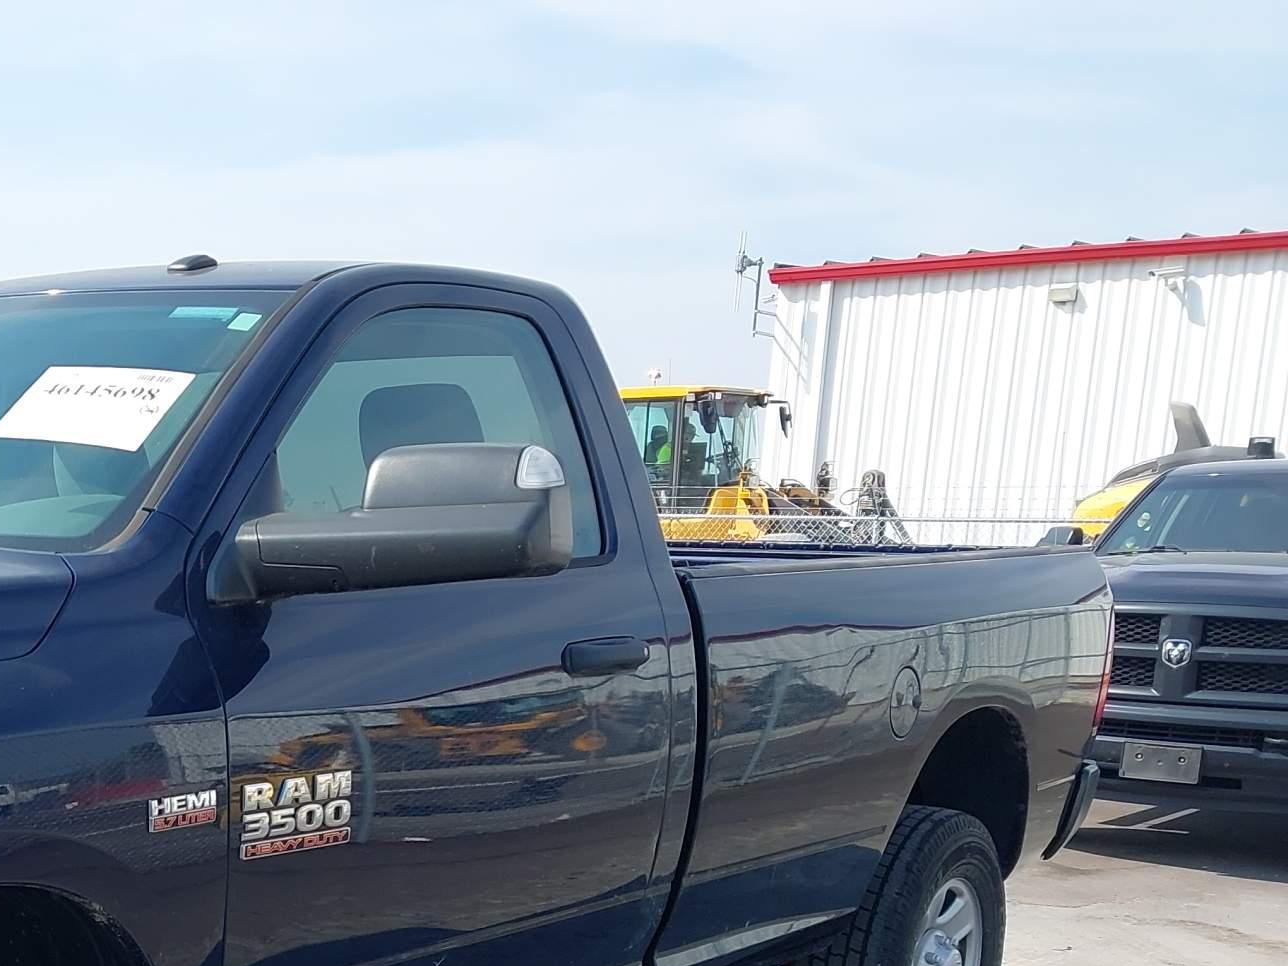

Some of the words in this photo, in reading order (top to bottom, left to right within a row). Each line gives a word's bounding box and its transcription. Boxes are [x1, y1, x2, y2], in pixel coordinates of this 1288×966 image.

[44, 384, 161, 401] 46145698
[149, 790, 217, 816] HEMI
[243, 771, 352, 811] RAM
[153, 816, 174, 831] 5.7
[177, 808, 216, 826] LITER
[241, 799, 352, 841] 3500
[247, 837, 301, 857] HEAVY
[303, 830, 349, 848] DUTY
